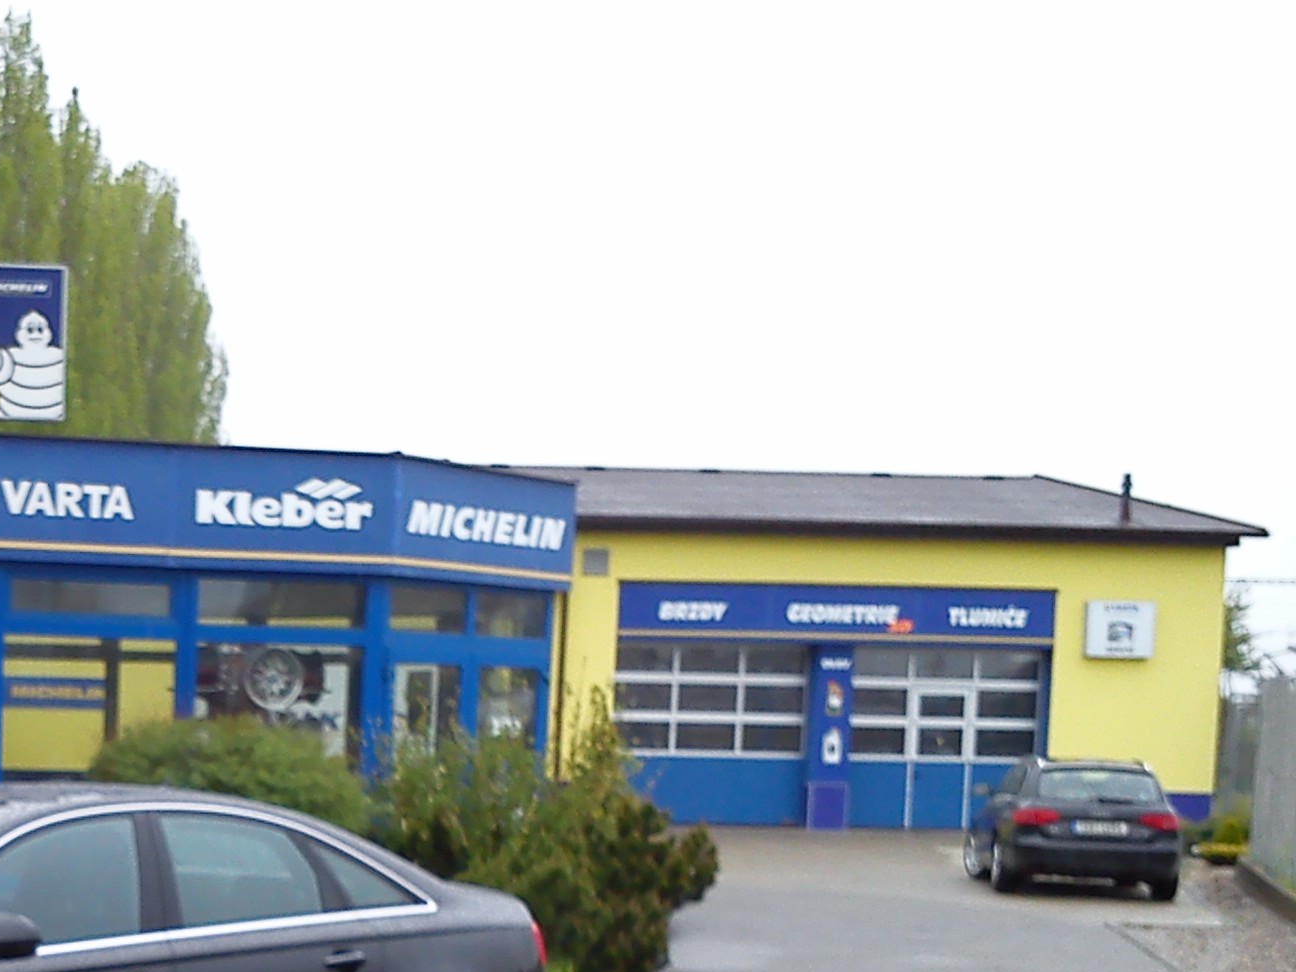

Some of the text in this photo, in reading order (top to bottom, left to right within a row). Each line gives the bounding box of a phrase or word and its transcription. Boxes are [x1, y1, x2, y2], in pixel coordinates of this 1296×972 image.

[1, 480, 134, 521] VARTA
[195, 488, 374, 531] Kleber
[406, 500, 567, 551] MICHELIN
[658, 600, 729, 622] BRZDY
[786, 603, 900, 625] GEOMETRIE
